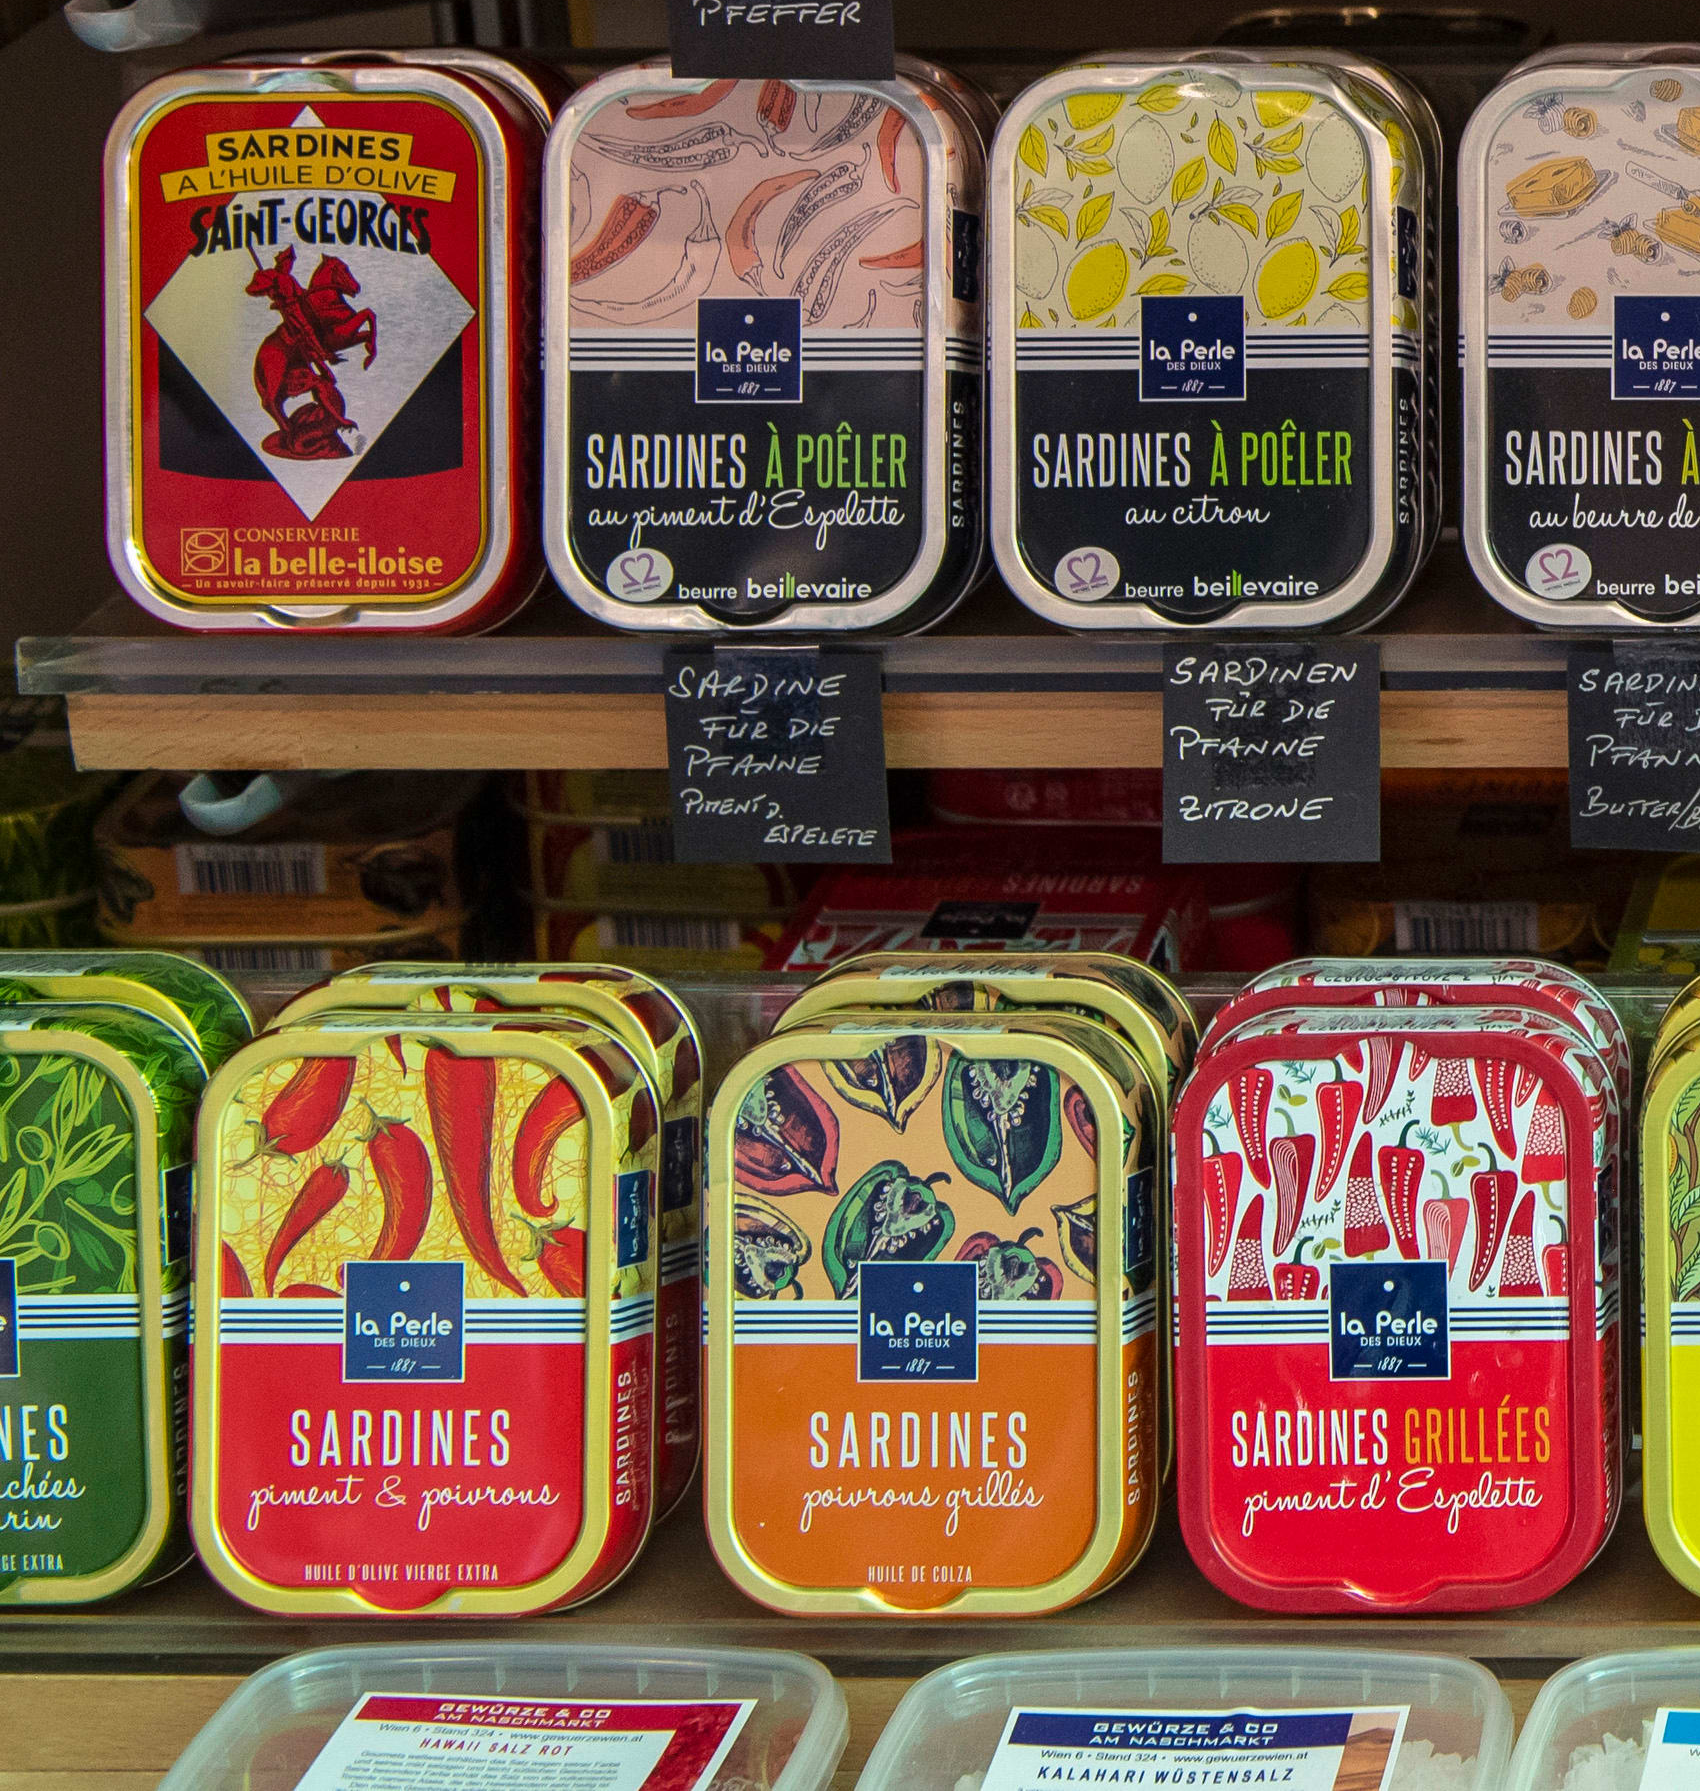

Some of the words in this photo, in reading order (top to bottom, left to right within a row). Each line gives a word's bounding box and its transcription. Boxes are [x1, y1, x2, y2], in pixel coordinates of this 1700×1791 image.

[217, 133, 401, 164] SARDINES
[177, 172, 196, 191] A
[202, 165, 316, 190] L'HUILE
[323, 165, 439, 195] D'OLIVE
[704, 340, 728, 363] la
[735, 340, 792, 363] Perle
[587, 432, 746, 491] SARDINES
[764, 422, 785, 489] À
[795, 422, 906, 489] POÊLER
[1125, 508, 1166, 526] au
[1171, 497, 1270, 526] citron
[233, 546, 261, 575] la
[268, 546, 443, 576] belle-iloise
[678, 583, 737, 601] beurre
[746, 571, 871, 601] beillevaire
[683, 745, 822, 776] PFANNE
[1180, 797, 1332, 821] ZITRONE
[290, 1409, 510, 1467] SARDINES
[808, 1411, 1028, 1470] SARDINES
[1232, 1409, 1390, 1468] SARDINES
[1405, 1395, 1552, 1465] GRILLÉES
[246, 1475, 362, 1531] piment
[375, 1475, 406, 1505] &
[418, 1487, 559, 1531] poivrons
[1037, 1765, 1147, 1783] KALAHARI
[1155, 1763, 1294, 1786] WÜSTENSALZ
